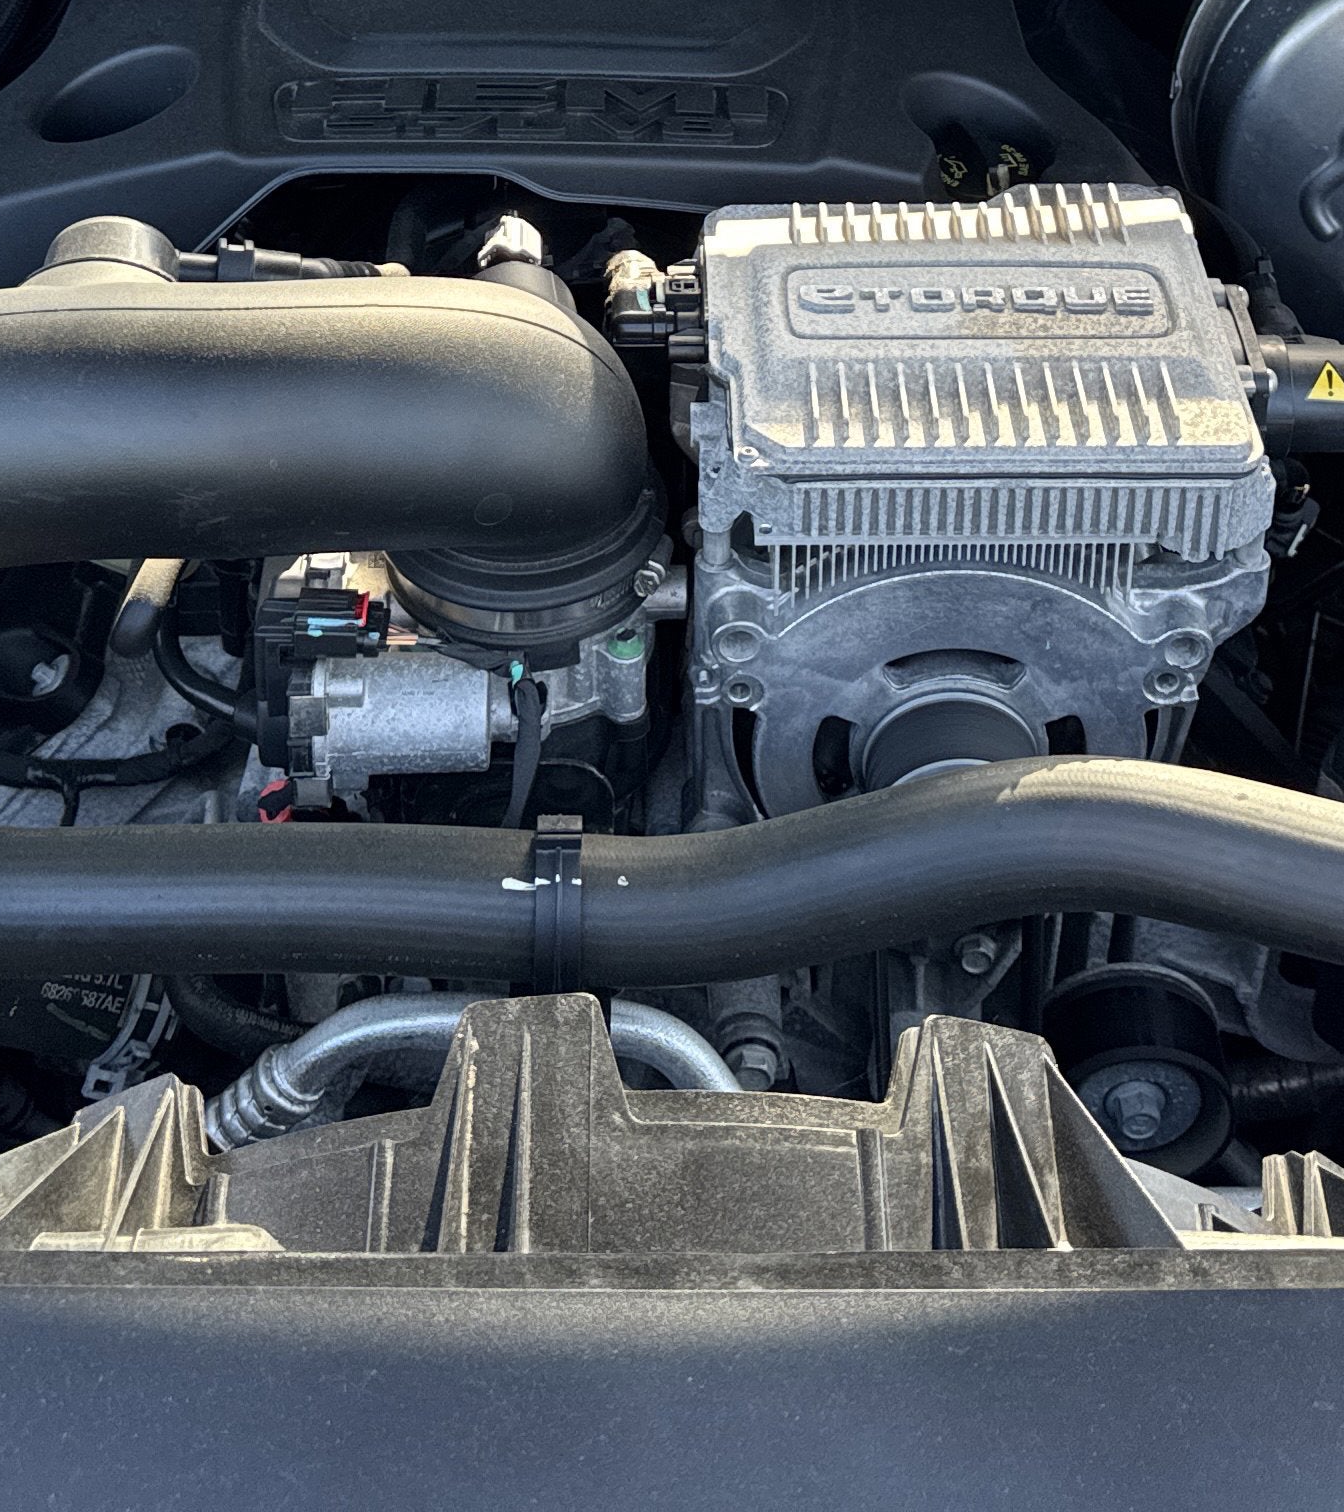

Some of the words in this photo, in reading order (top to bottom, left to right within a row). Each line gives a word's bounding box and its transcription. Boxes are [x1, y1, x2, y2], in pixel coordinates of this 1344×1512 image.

[290, 77, 769, 121] HEMI
[591, 117, 735, 140] V8
[797, 283, 1155, 316] eTORQUE
